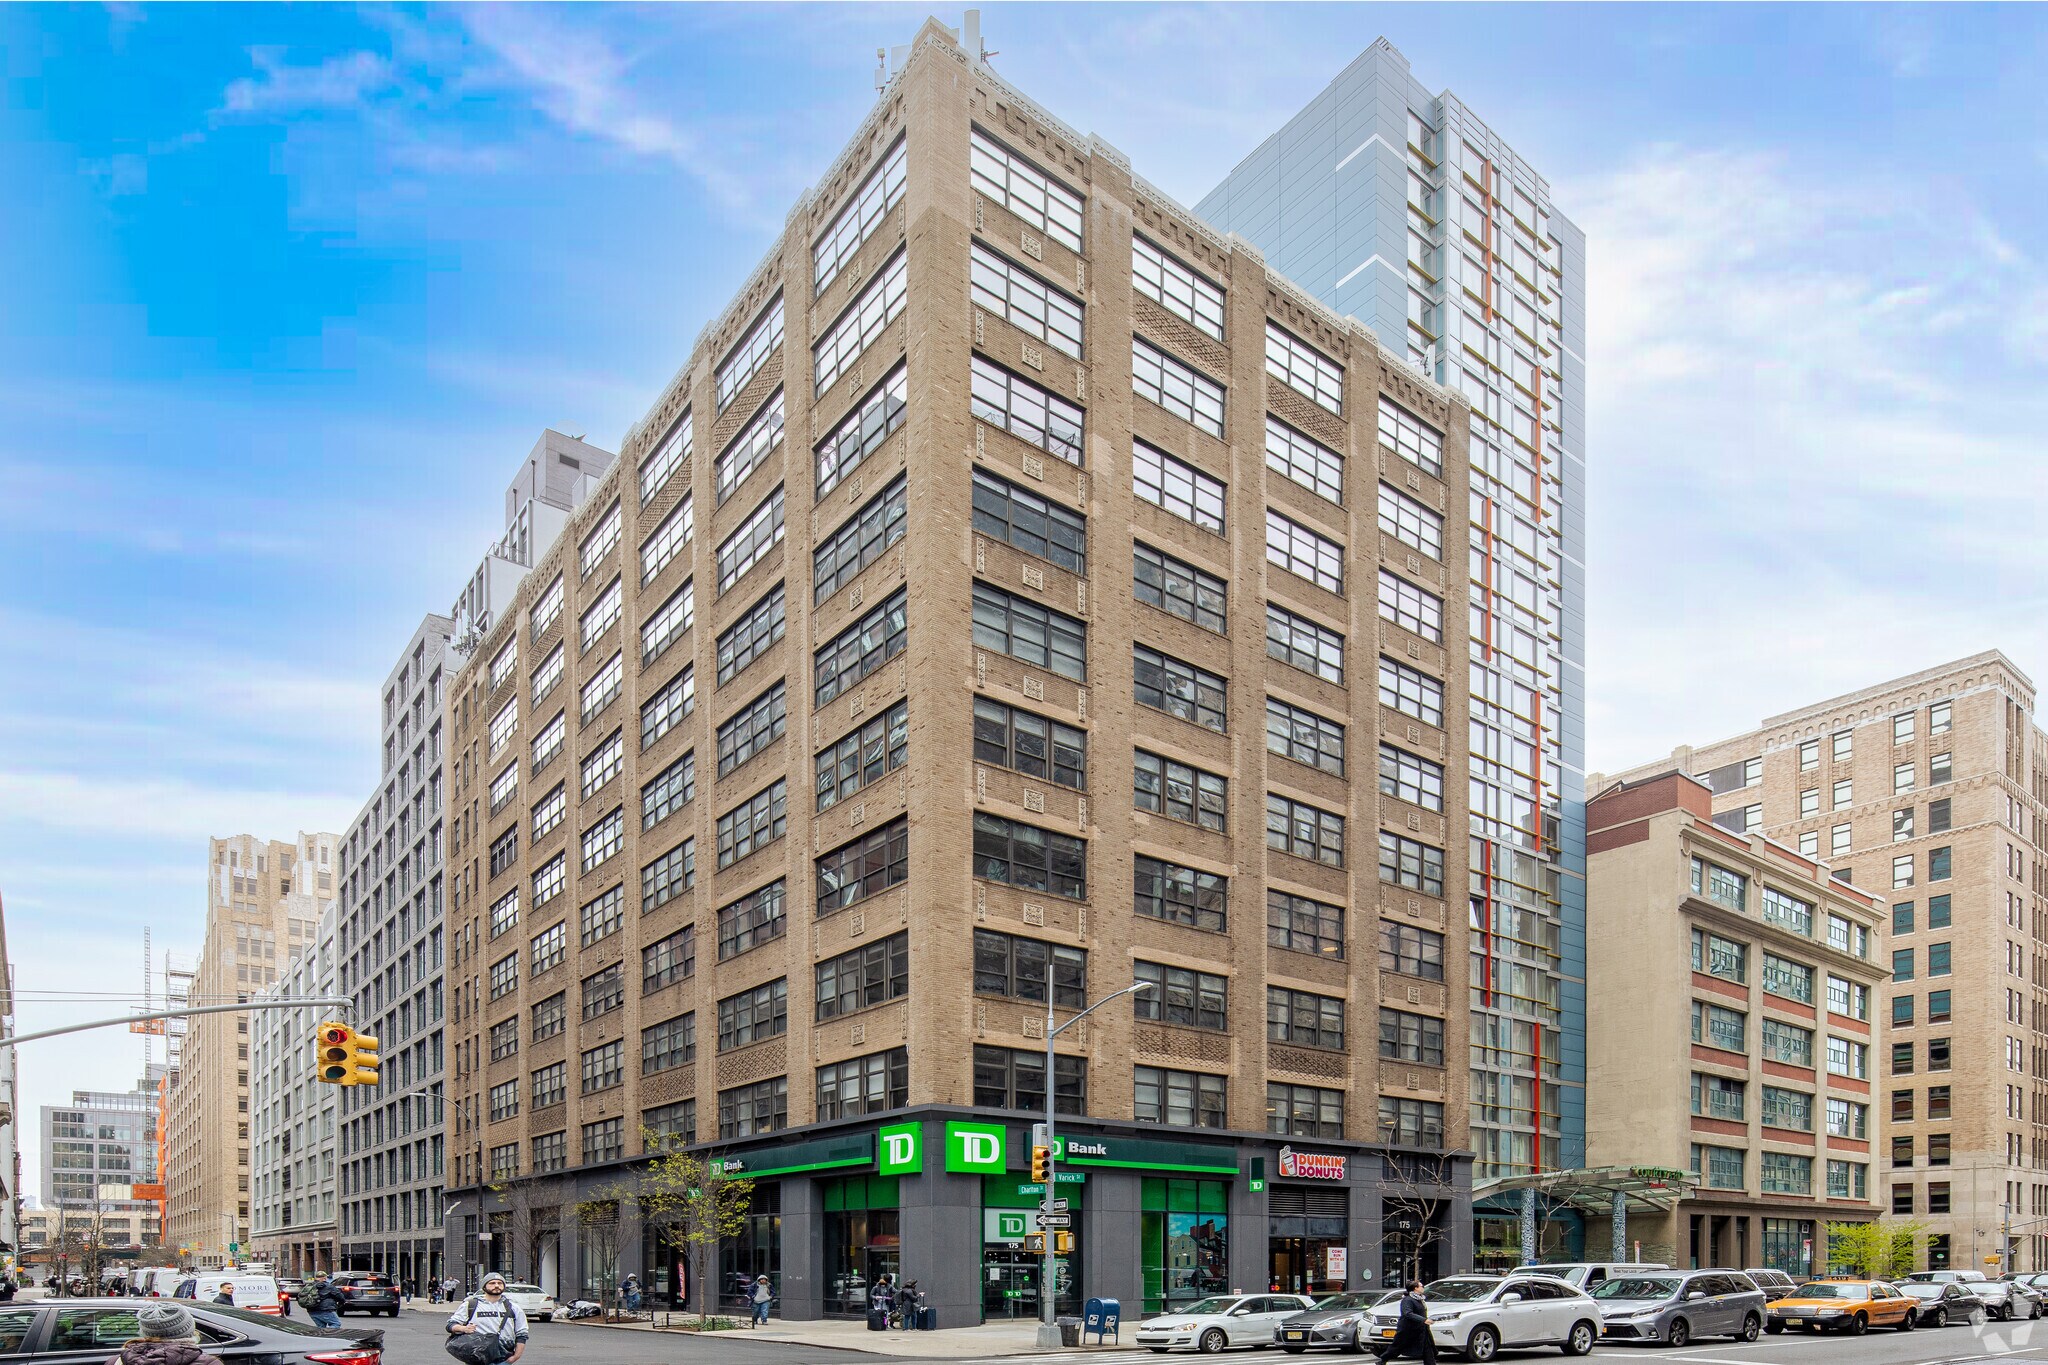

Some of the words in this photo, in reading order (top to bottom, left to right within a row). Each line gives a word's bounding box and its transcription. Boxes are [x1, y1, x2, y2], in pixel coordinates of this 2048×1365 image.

[883, 1133, 915, 1165] TD
[954, 1131, 1000, 1164] TD
[1068, 1141, 1107, 1155] Bank
[723, 1160, 743, 1171] Bank
[1298, 1154, 1346, 1168] DUNKIN'
[1058, 1174, 1075, 1182] Varick
[1298, 1165, 1344, 1179] DONUTS
[1021, 1186, 1040, 1194] Charlton
[1252, 1181, 1263, 1190] TD
[1001, 1217, 1024, 1233] TD
[1398, 1220, 1411, 1229] 175
